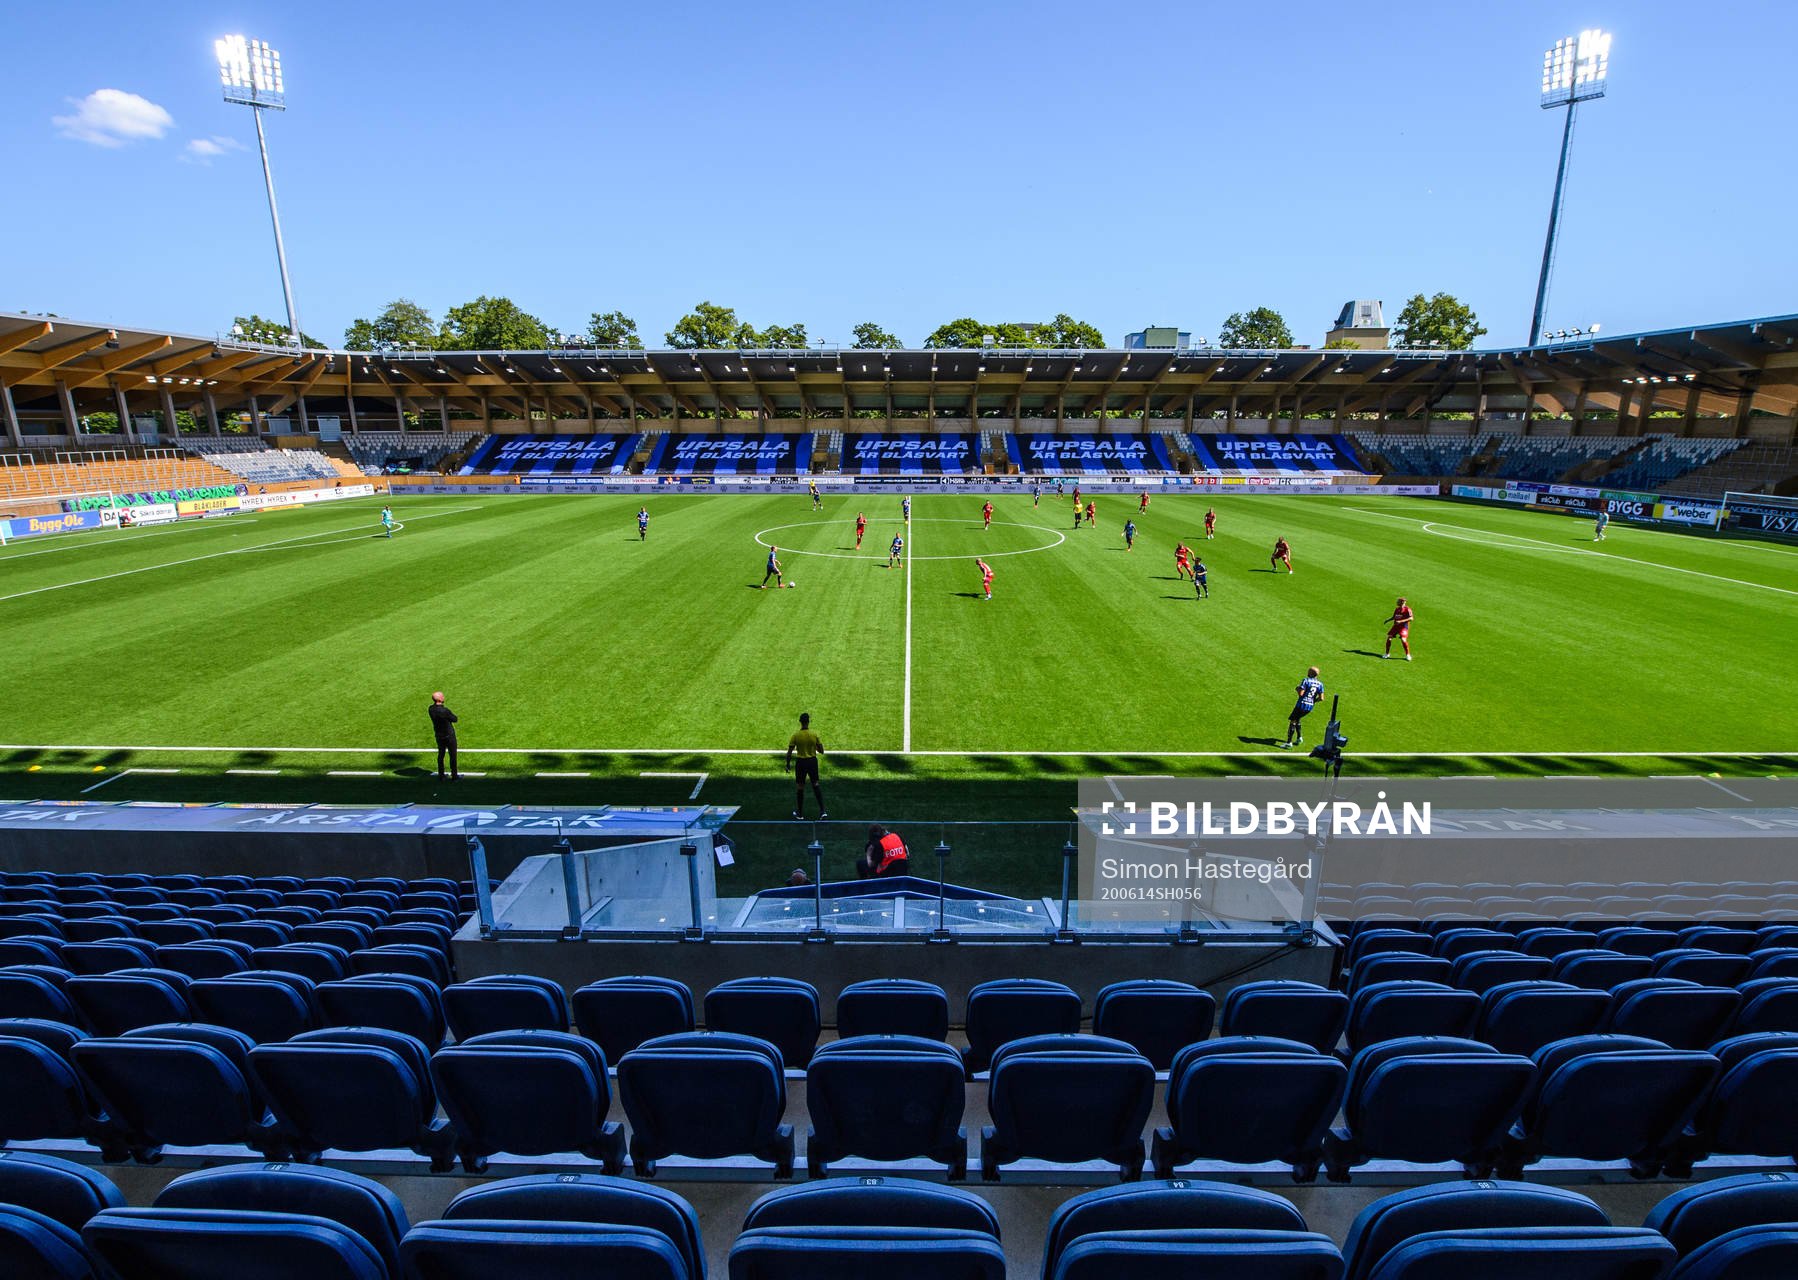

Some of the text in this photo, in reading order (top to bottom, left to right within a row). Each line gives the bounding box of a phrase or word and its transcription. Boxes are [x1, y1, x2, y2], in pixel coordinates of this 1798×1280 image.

[501, 441, 616, 451] UPPSALA
[676, 441, 790, 451] UPPSALA
[855, 441, 969, 450] UPPSALA
[1029, 441, 1146, 451] UPPSALA
[1216, 441, 1333, 451] UPPSALA
[242, 495, 288, 506] HYREX HYREX
[1607, 500, 1644, 515] BYGG
[103, 509, 136, 522] DAC
[1677, 507, 1711, 520] weber
[29, 513, 84, 534] Bygg-Ole
[239, 809, 420, 827] ÅRSTA
[503, 815, 614, 828] TAK
[885, 847, 904, 858] FOTO
